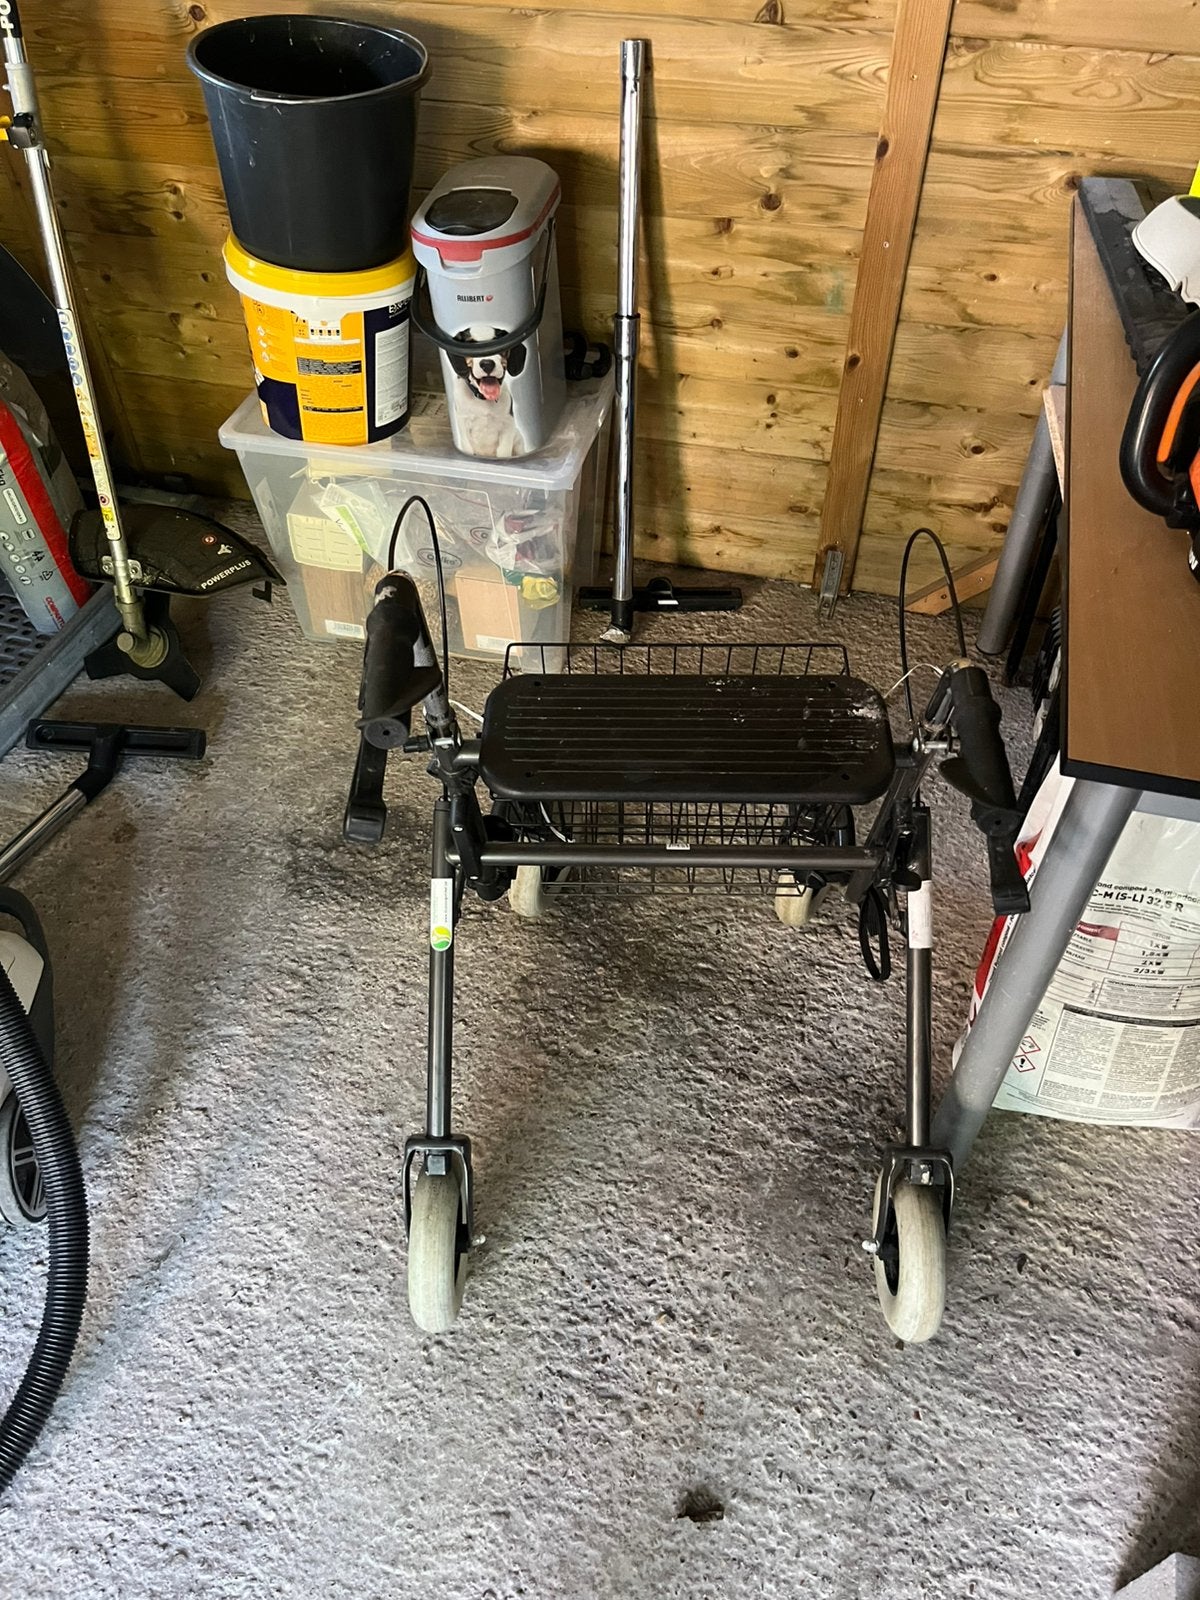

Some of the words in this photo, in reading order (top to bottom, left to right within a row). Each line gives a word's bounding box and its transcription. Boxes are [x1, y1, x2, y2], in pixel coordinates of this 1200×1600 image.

[0, 0, 14, 29] PO
[201, 559, 251, 589] POWERPLUS
[1146, 896, 1172, 909] 32,5
[1175, 902, 1184, 912] R
